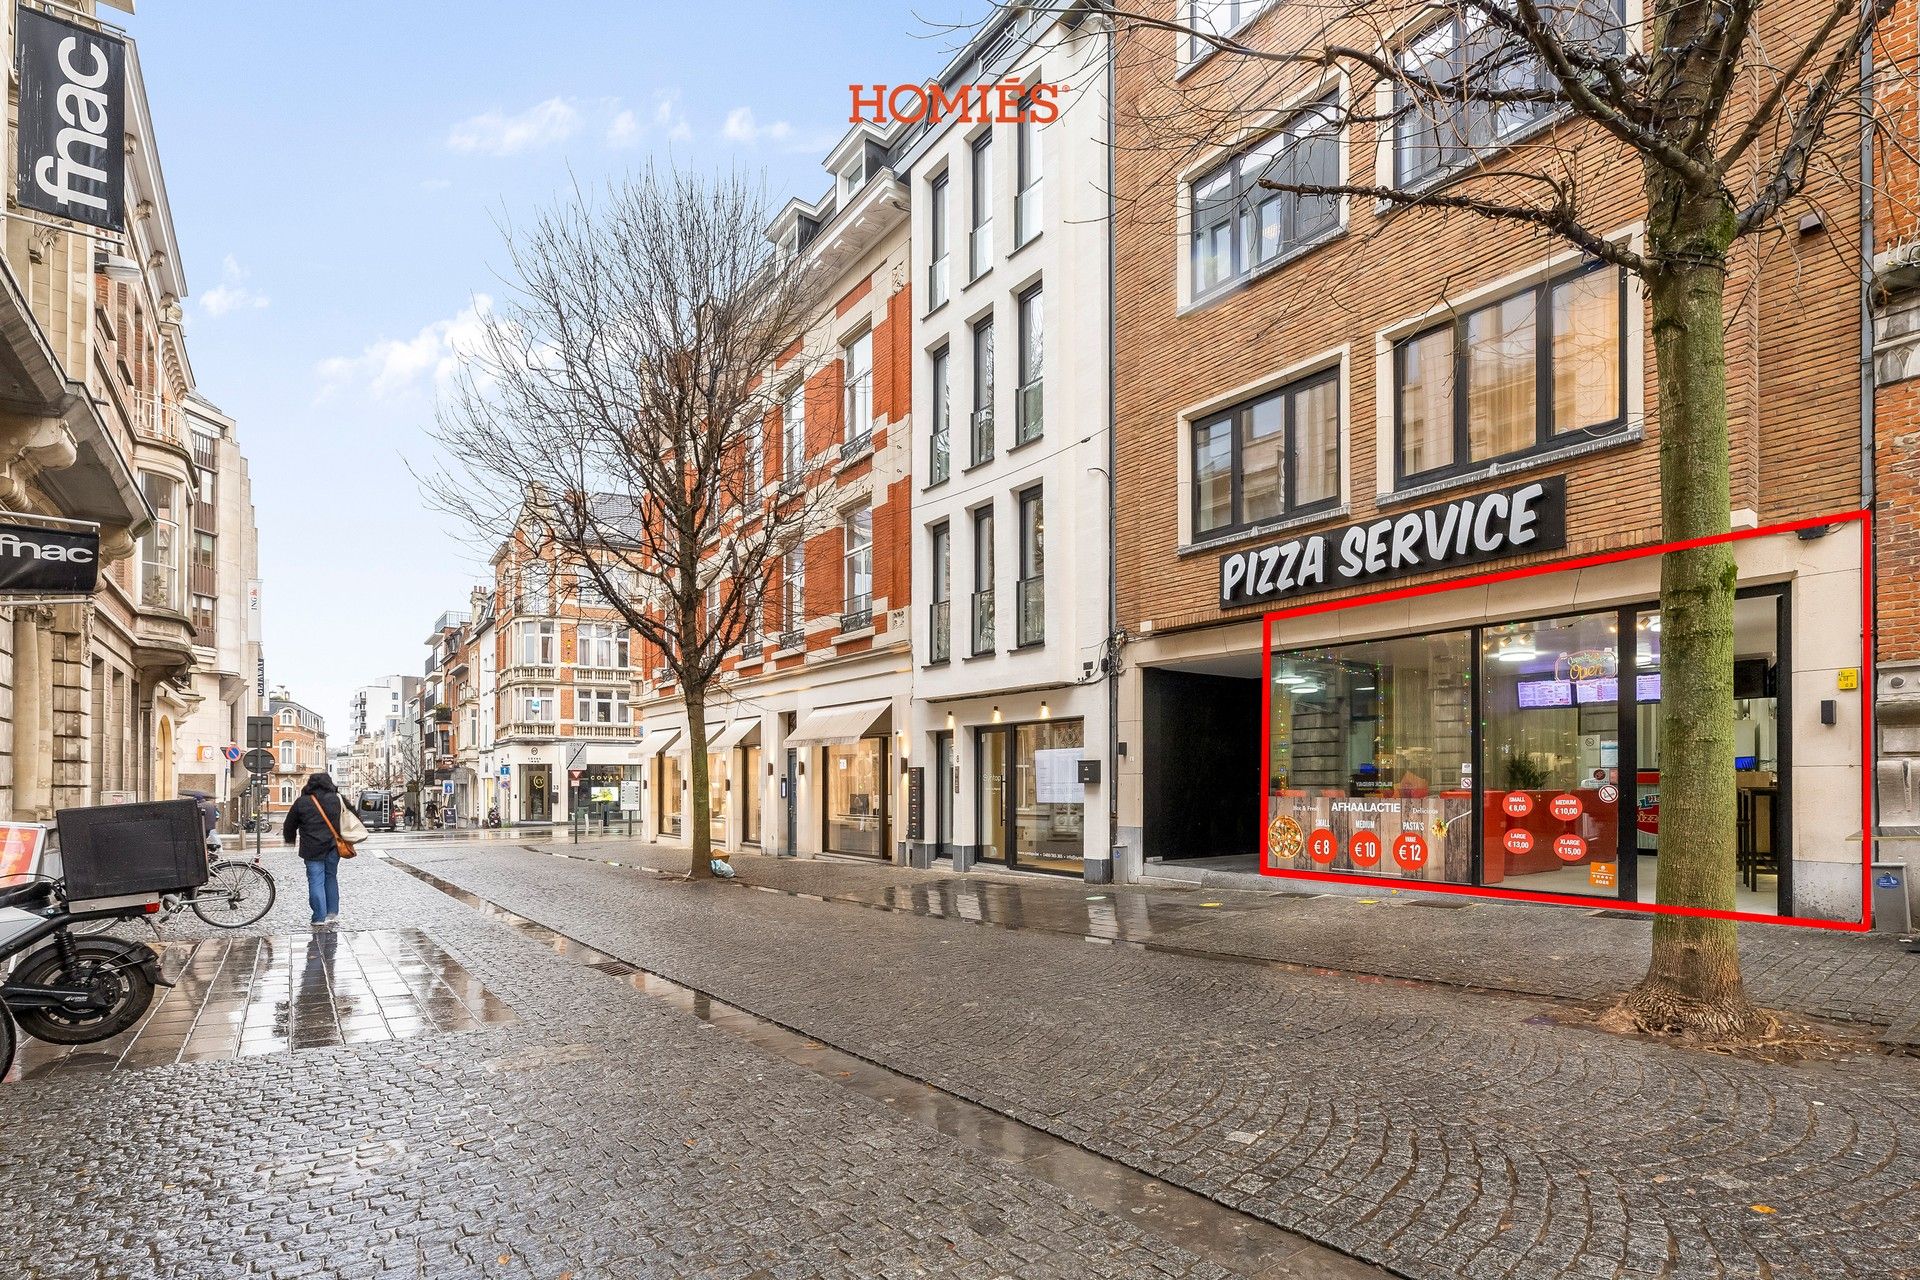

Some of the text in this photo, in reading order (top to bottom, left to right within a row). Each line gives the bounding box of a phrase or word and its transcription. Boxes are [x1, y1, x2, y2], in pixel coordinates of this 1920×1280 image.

[35, 36, 109, 210] fnac
[1223, 483, 1544, 600] PIZZA SERVICE
[0, 533, 94, 564] fnac
[1569, 664, 1605, 681] Open
[1331, 802, 1401, 813] AFHAALACTIE
[1412, 807, 1439, 815] Delicious
[1315, 818, 1330, 827] SMALL
[1355, 819, 1375, 829] MEDIUM
[1403, 821, 1425, 831] PASTA'S
[1314, 839, 1330, 855] € 8
[1354, 841, 1376, 858] € 10
[1512, 841, 1529, 849] 13,00
[1564, 847, 1581, 855] 15,00
[1398, 845, 1421, 861] € 12
